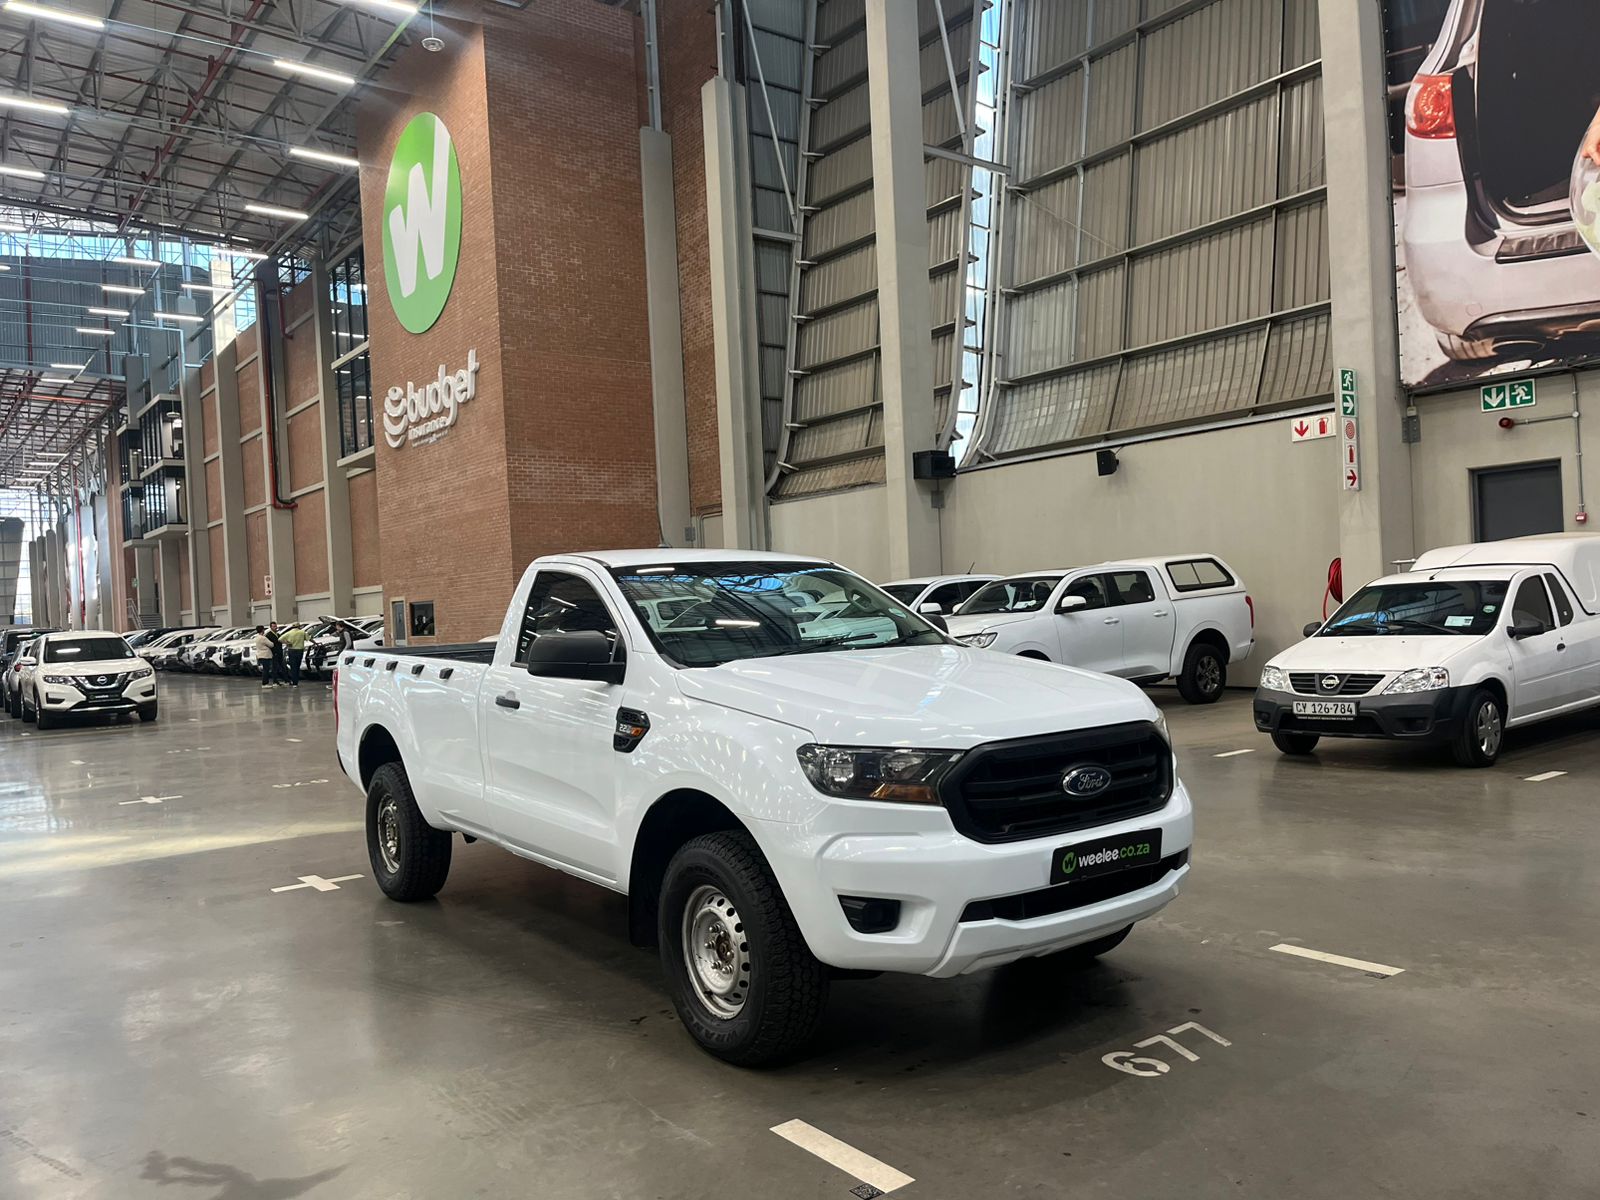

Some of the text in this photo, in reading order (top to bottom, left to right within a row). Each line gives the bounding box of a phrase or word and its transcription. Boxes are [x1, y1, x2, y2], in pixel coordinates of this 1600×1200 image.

[407, 348, 480, 426] budget
[1295, 702, 1307, 713] CY
[1077, 772, 1104, 791] Ford
[1078, 843, 1151, 868] weelee.co.za
[1101, 1021, 1233, 1077] 677
